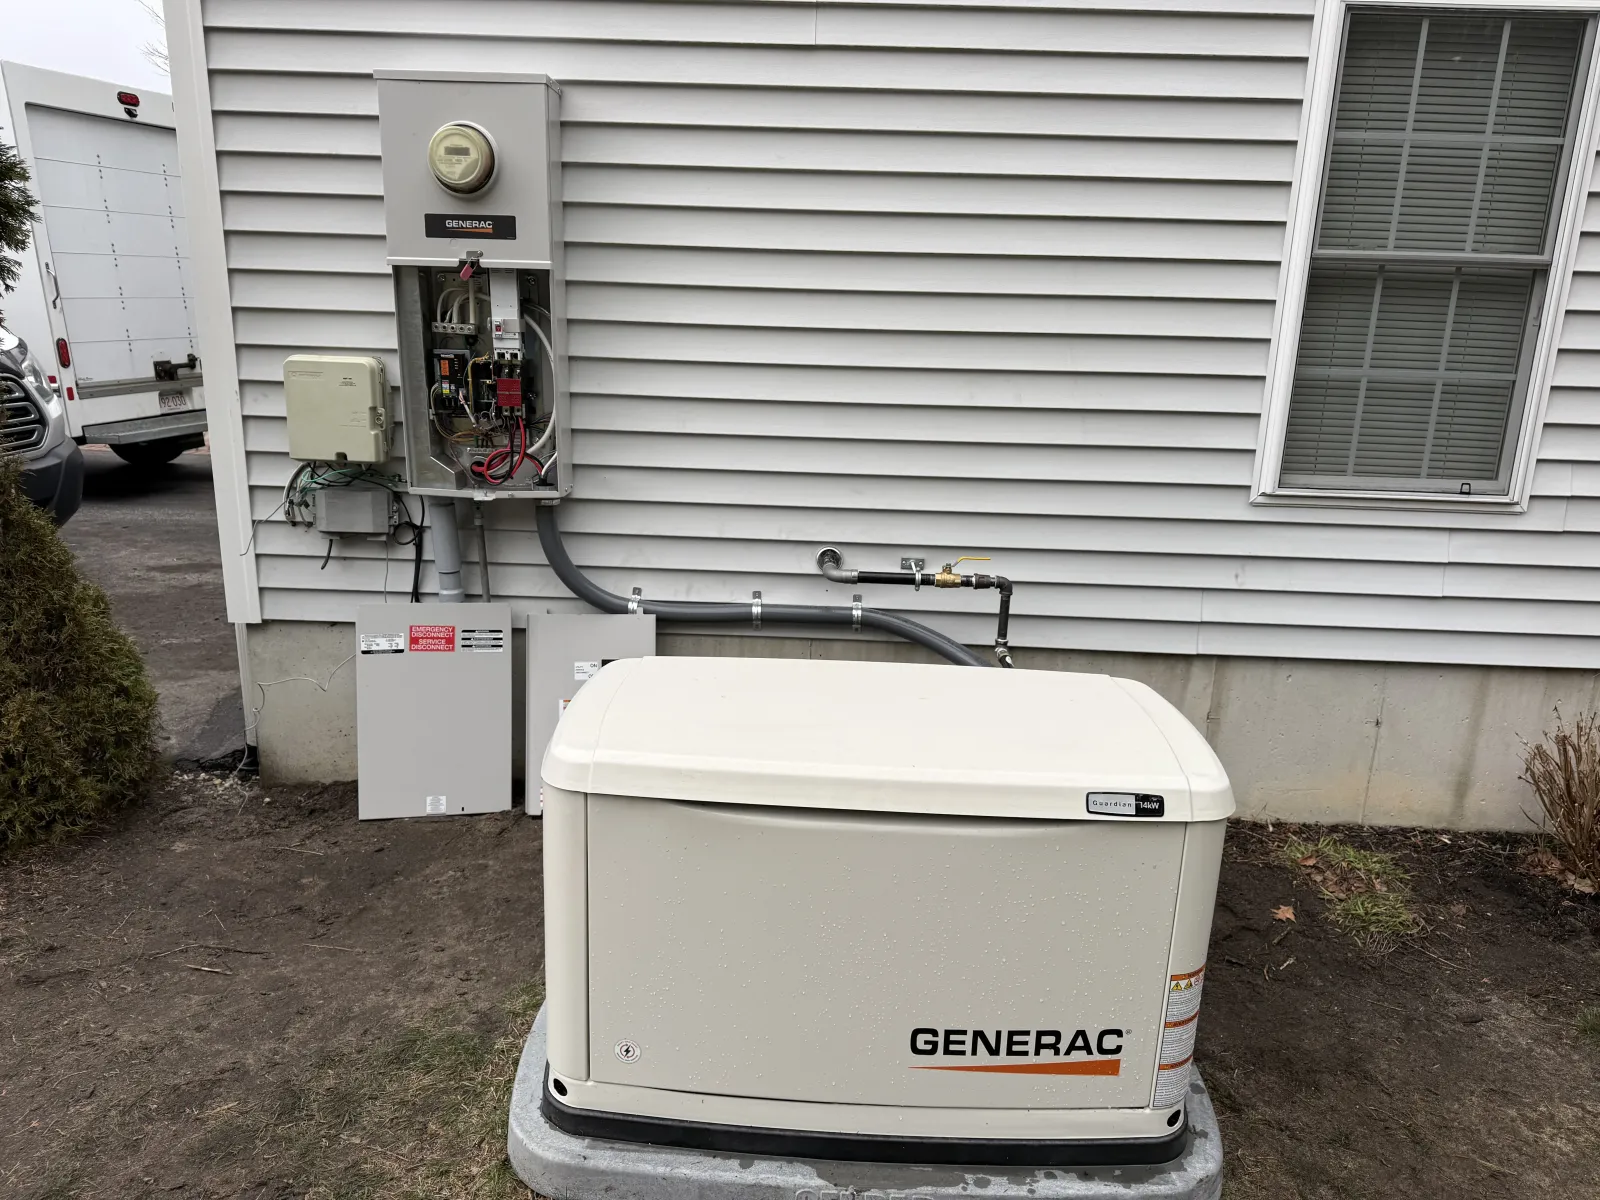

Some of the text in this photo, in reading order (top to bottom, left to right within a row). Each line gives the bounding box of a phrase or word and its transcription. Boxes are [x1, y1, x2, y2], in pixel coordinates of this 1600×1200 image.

[445, 219, 493, 228] GENERAC
[1092, 799, 1160, 809] Guardian 14kW
[909, 1027, 1125, 1057] GENERAC
